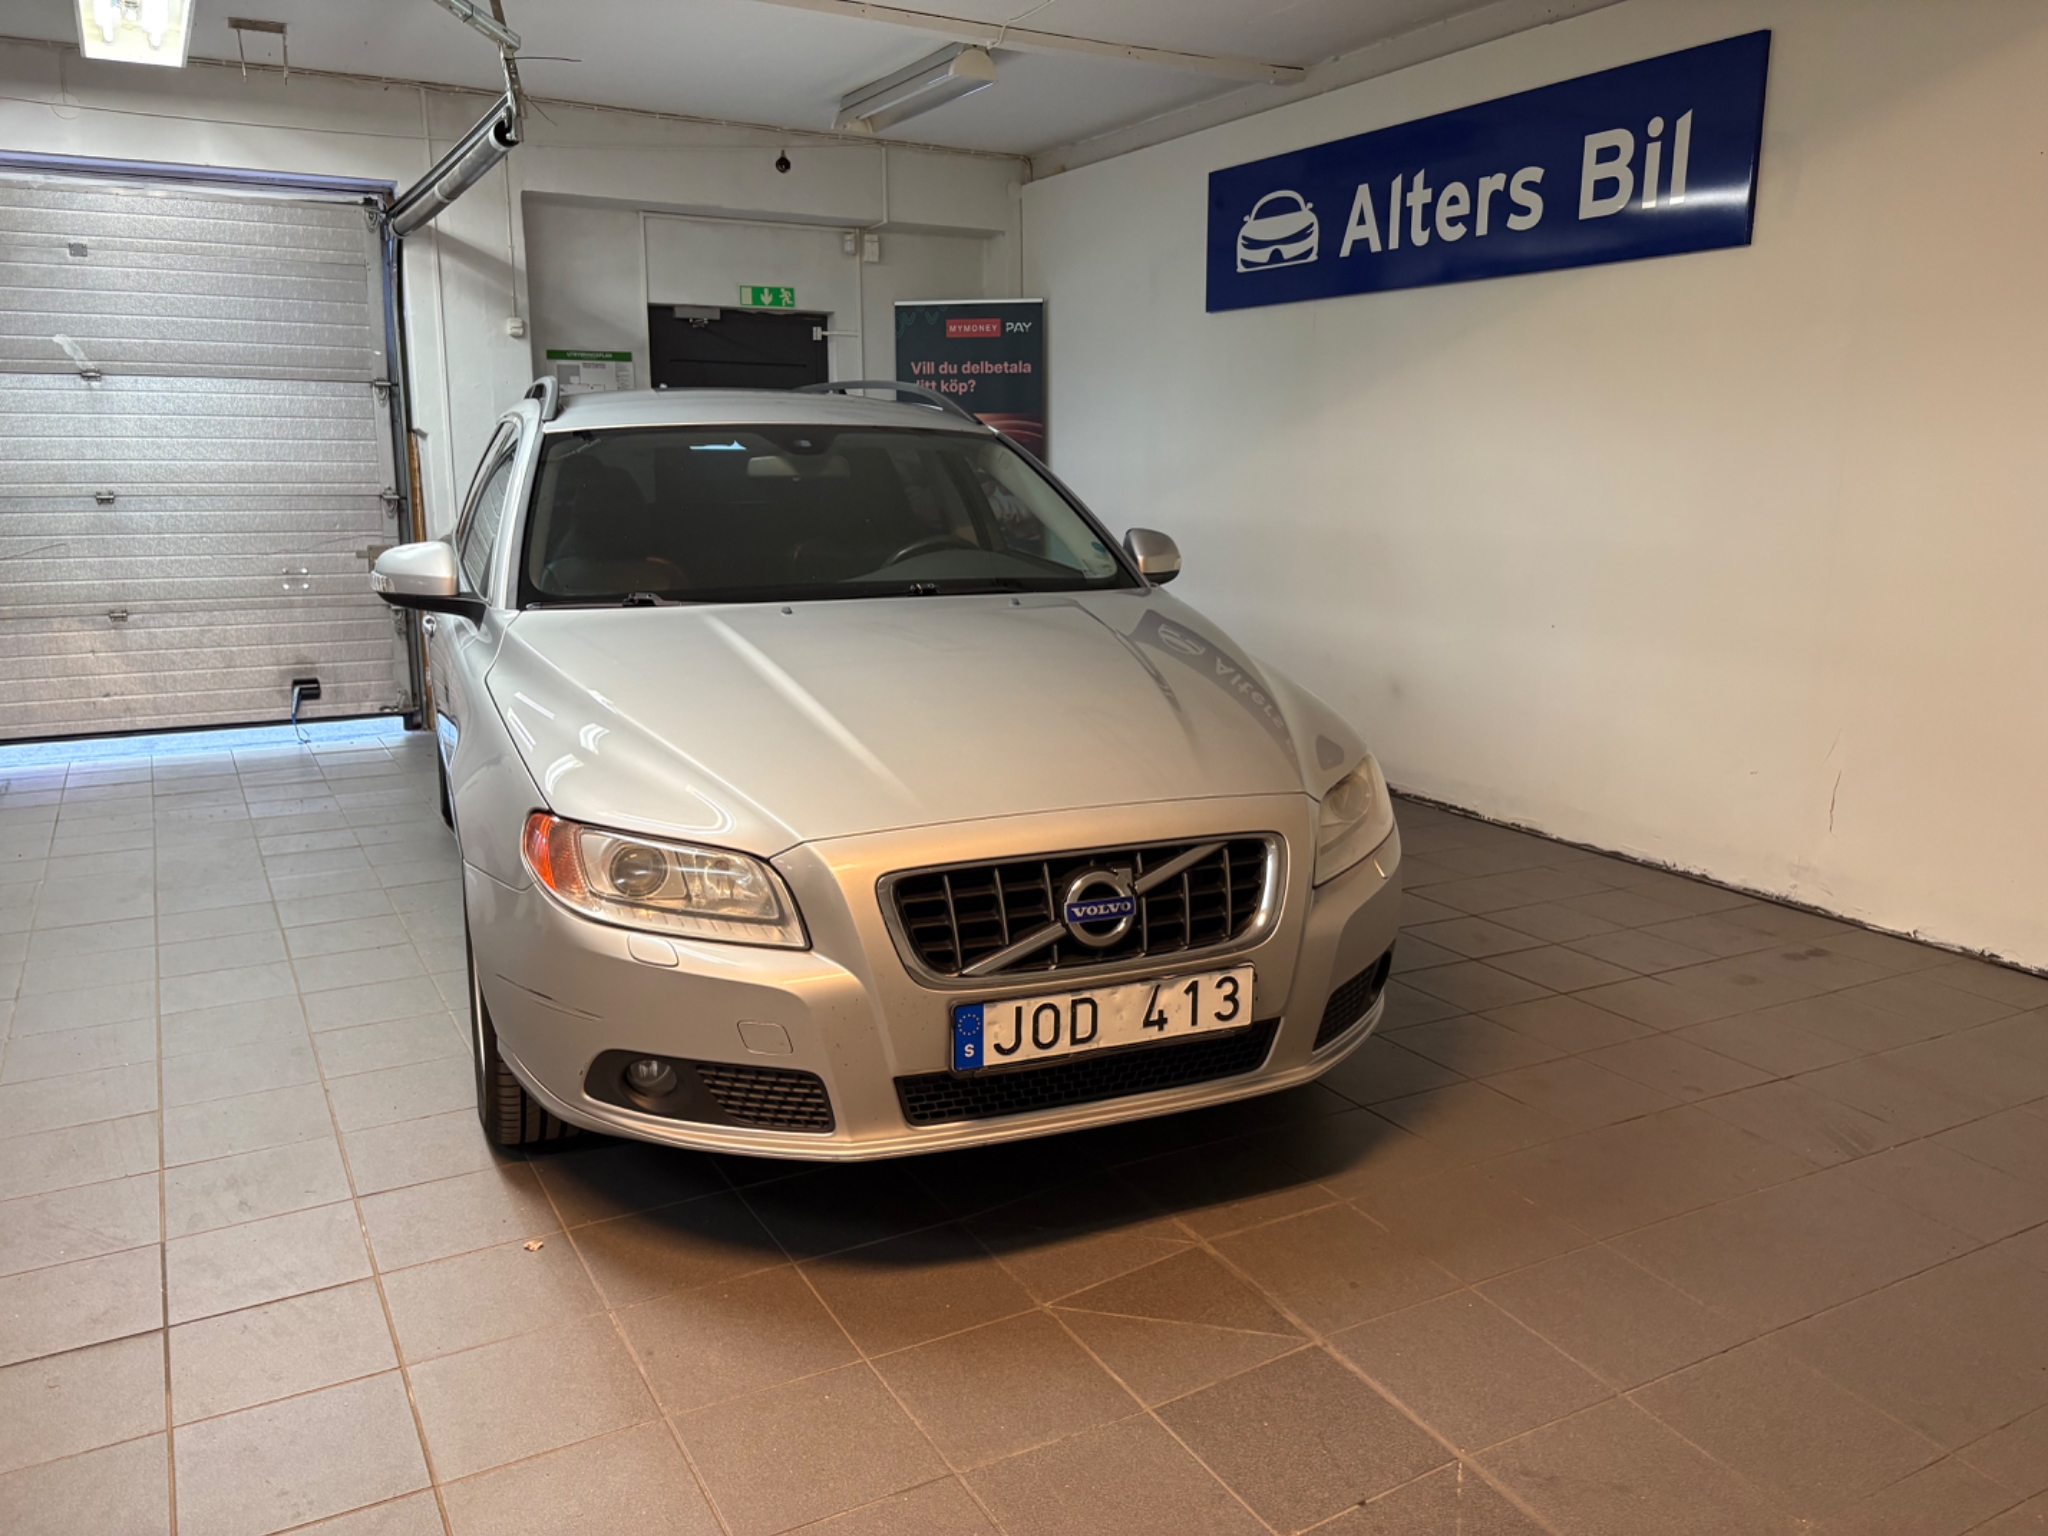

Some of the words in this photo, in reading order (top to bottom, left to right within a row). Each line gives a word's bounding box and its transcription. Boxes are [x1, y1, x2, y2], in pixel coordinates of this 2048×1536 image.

[1339, 166, 1545, 258] Alters
[1578, 108, 1693, 220] Bil
[949, 324, 998, 332] MYMONEY
[1005, 322, 1032, 332] PAY
[910, 361, 935, 375] Vill
[938, 361, 958, 374] du
[961, 360, 1032, 374] delbetala
[940, 379, 976, 395] köp?
[1071, 901, 1131, 917] VOLVO
[993, 997, 1099, 1056] JOD
[1142, 976, 1240, 1032] 413
[964, 1043, 975, 1058] S
